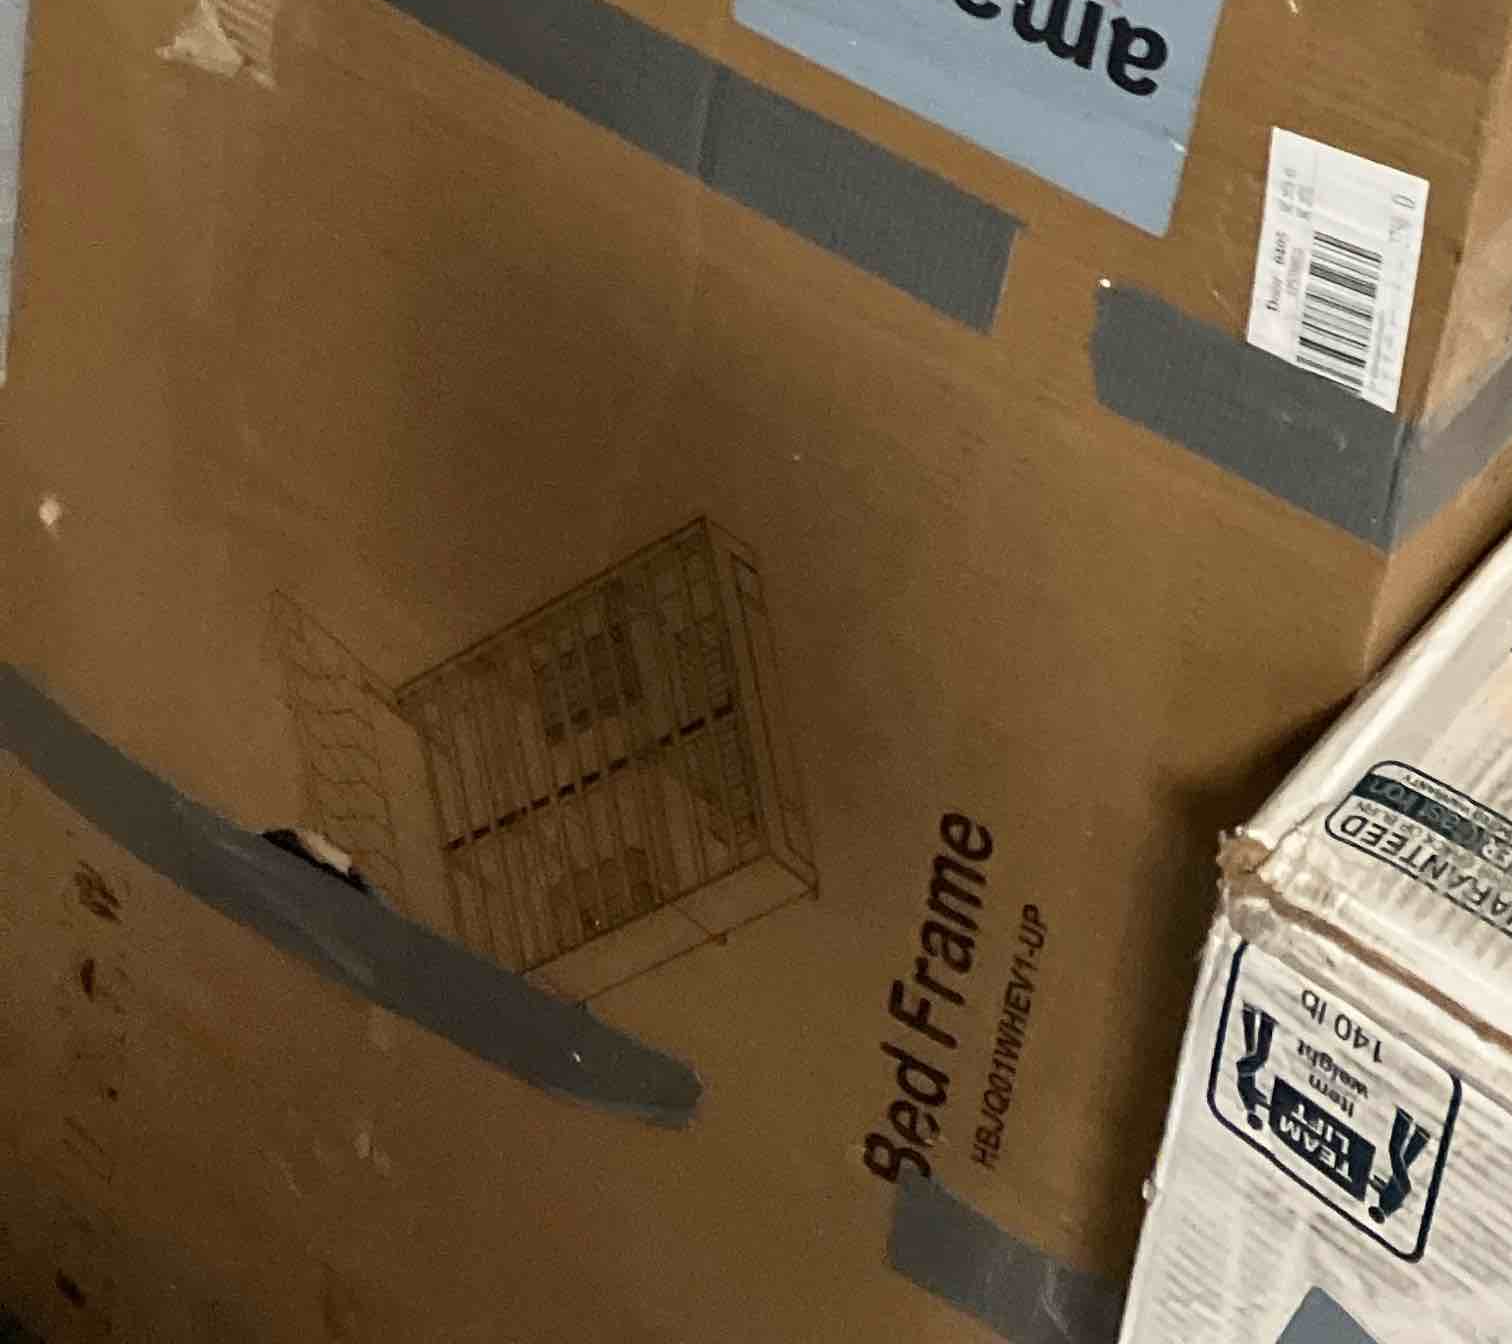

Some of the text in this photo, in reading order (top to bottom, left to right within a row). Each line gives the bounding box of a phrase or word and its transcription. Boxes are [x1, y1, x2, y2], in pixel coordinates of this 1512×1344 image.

[864, 814, 995, 1189] Bed Frame
[1301, 989, 1383, 1063] 140 lb
[971, 903, 1052, 1170] HBJQ01WHEV1-UP
[1297, 1038, 1369, 1100] weight
[1291, 1103, 1351, 1156] LIFT
[1308, 1074, 1355, 1119] Item
[1280, 1114, 1352, 1183] TEAM
